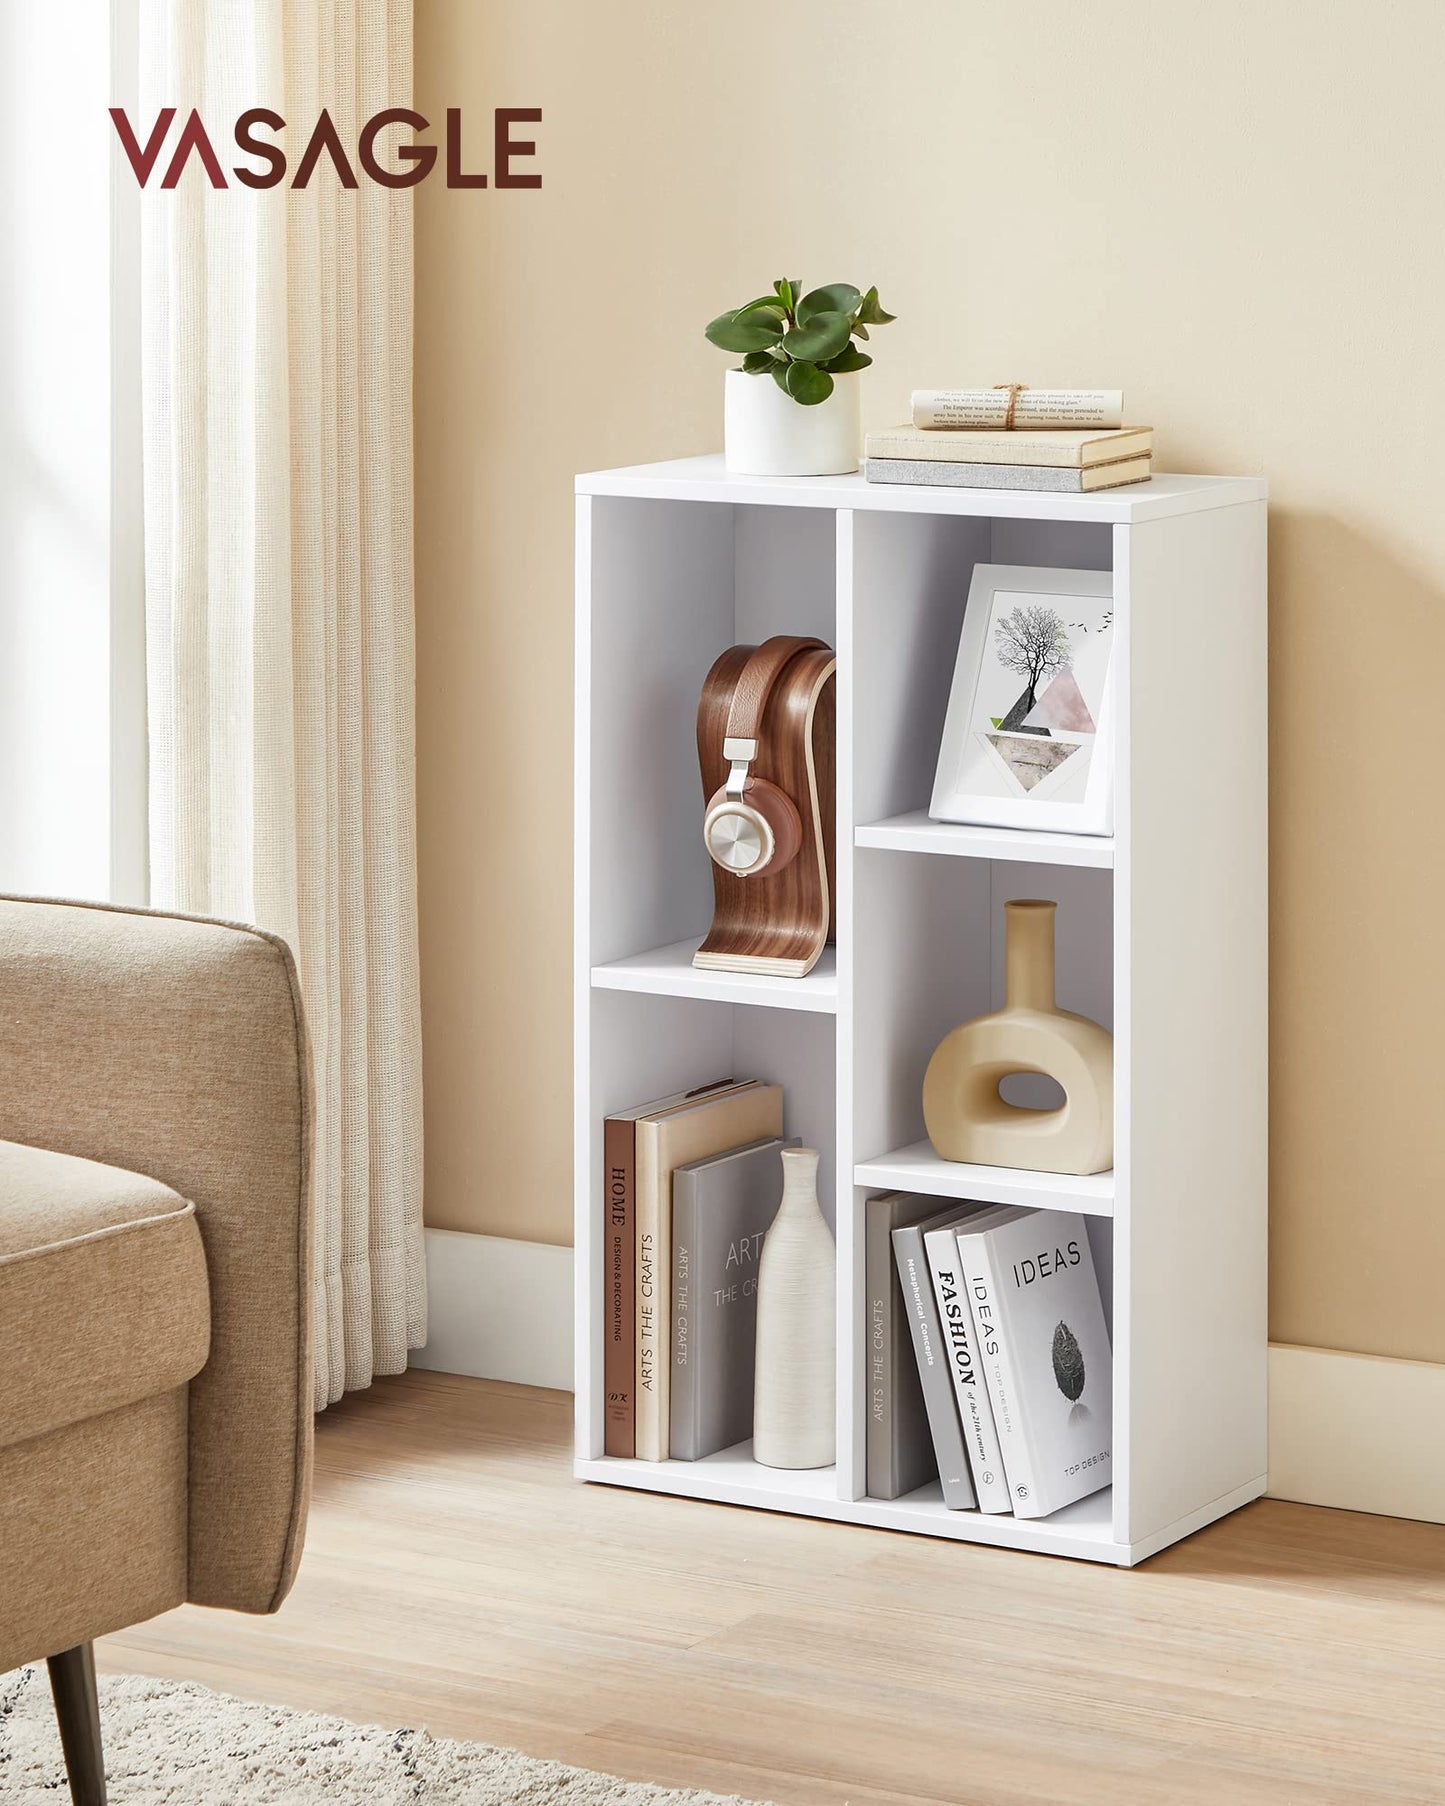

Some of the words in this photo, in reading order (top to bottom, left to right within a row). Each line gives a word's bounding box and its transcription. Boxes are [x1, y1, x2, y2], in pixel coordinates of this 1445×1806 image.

[611, 1167, 626, 1226] HOME
[614, 1236, 622, 1271] DESIGN
[641, 1234, 653, 1298] CRAFTS
[679, 1246, 688, 1278] ARTS
[725, 1231, 765, 1270] ART
[1012, 1241, 1082, 1288] IDEAS
[614, 1281, 622, 1342] DECORATING
[678, 1286, 688, 1314] THE
[712, 1284, 738, 1307] THE
[906, 1258, 925, 1320] Metaphorical
[920, 1322, 934, 1366] Concepts
[641, 1305, 653, 1340] THE
[677, 1317, 687, 1365] CRAFTS
[874, 1299, 884, 1349] CRAFTS
[938, 1270, 976, 1386] FASHION
[641, 1348, 653, 1391] ARTS
[874, 1354, 884, 1382] THE
[972, 1275, 1000, 1356] IDEAS
[994, 1364, 1003, 1386] TOP
[999, 1390, 1012, 1433] DESIGN
[874, 1389, 884, 1422] ARTS
[1064, 1464, 1080, 1476] TOP
